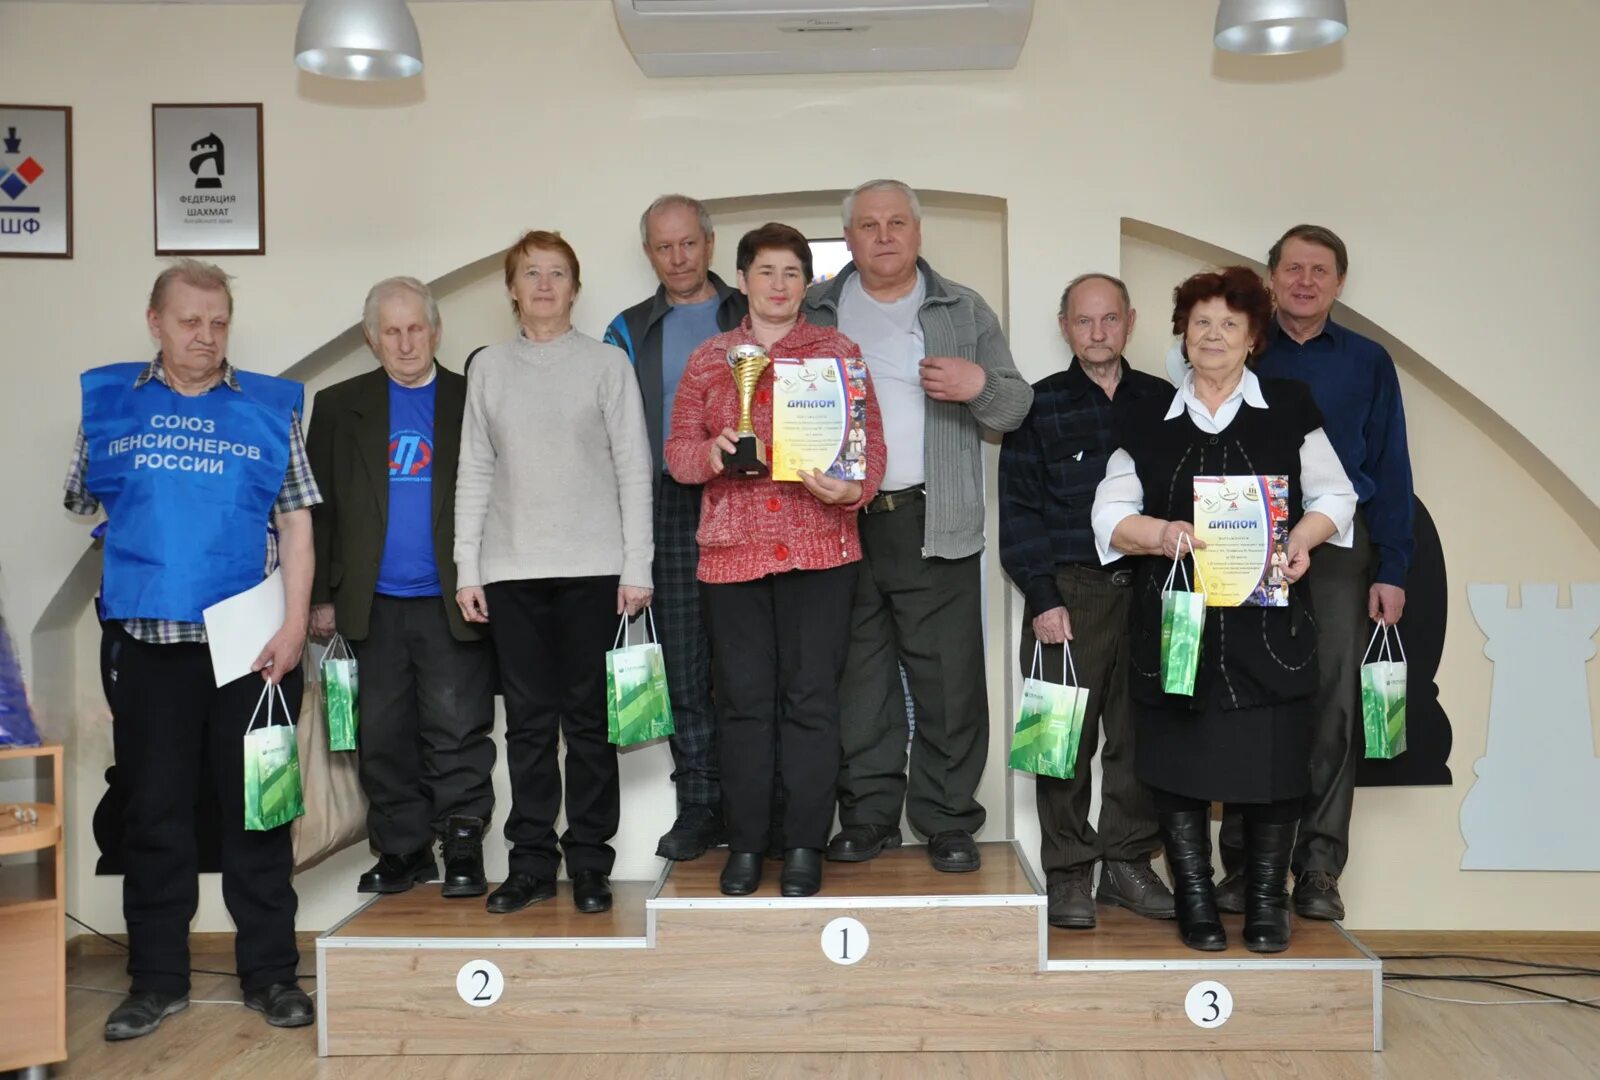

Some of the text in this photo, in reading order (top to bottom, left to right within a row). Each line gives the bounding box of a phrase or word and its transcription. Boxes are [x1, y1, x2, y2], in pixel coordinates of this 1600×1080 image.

[179, 195, 236, 204] ФЕДЕРАЦИЯ
[186, 208, 229, 216] ШАХМАТ
[787, 400, 836, 409] ДИПЛОМ
[151, 414, 215, 434] СОЮЗ
[108, 433, 261, 460] ПЕНСИОНЕРОВ
[134, 452, 224, 475] РОССИИ
[1208, 520, 1258, 529] ДИПЛОМ
[838, 927, 851, 960] 1
[471, 969, 493, 1001] 2
[1202, 990, 1220, 1022] 3
